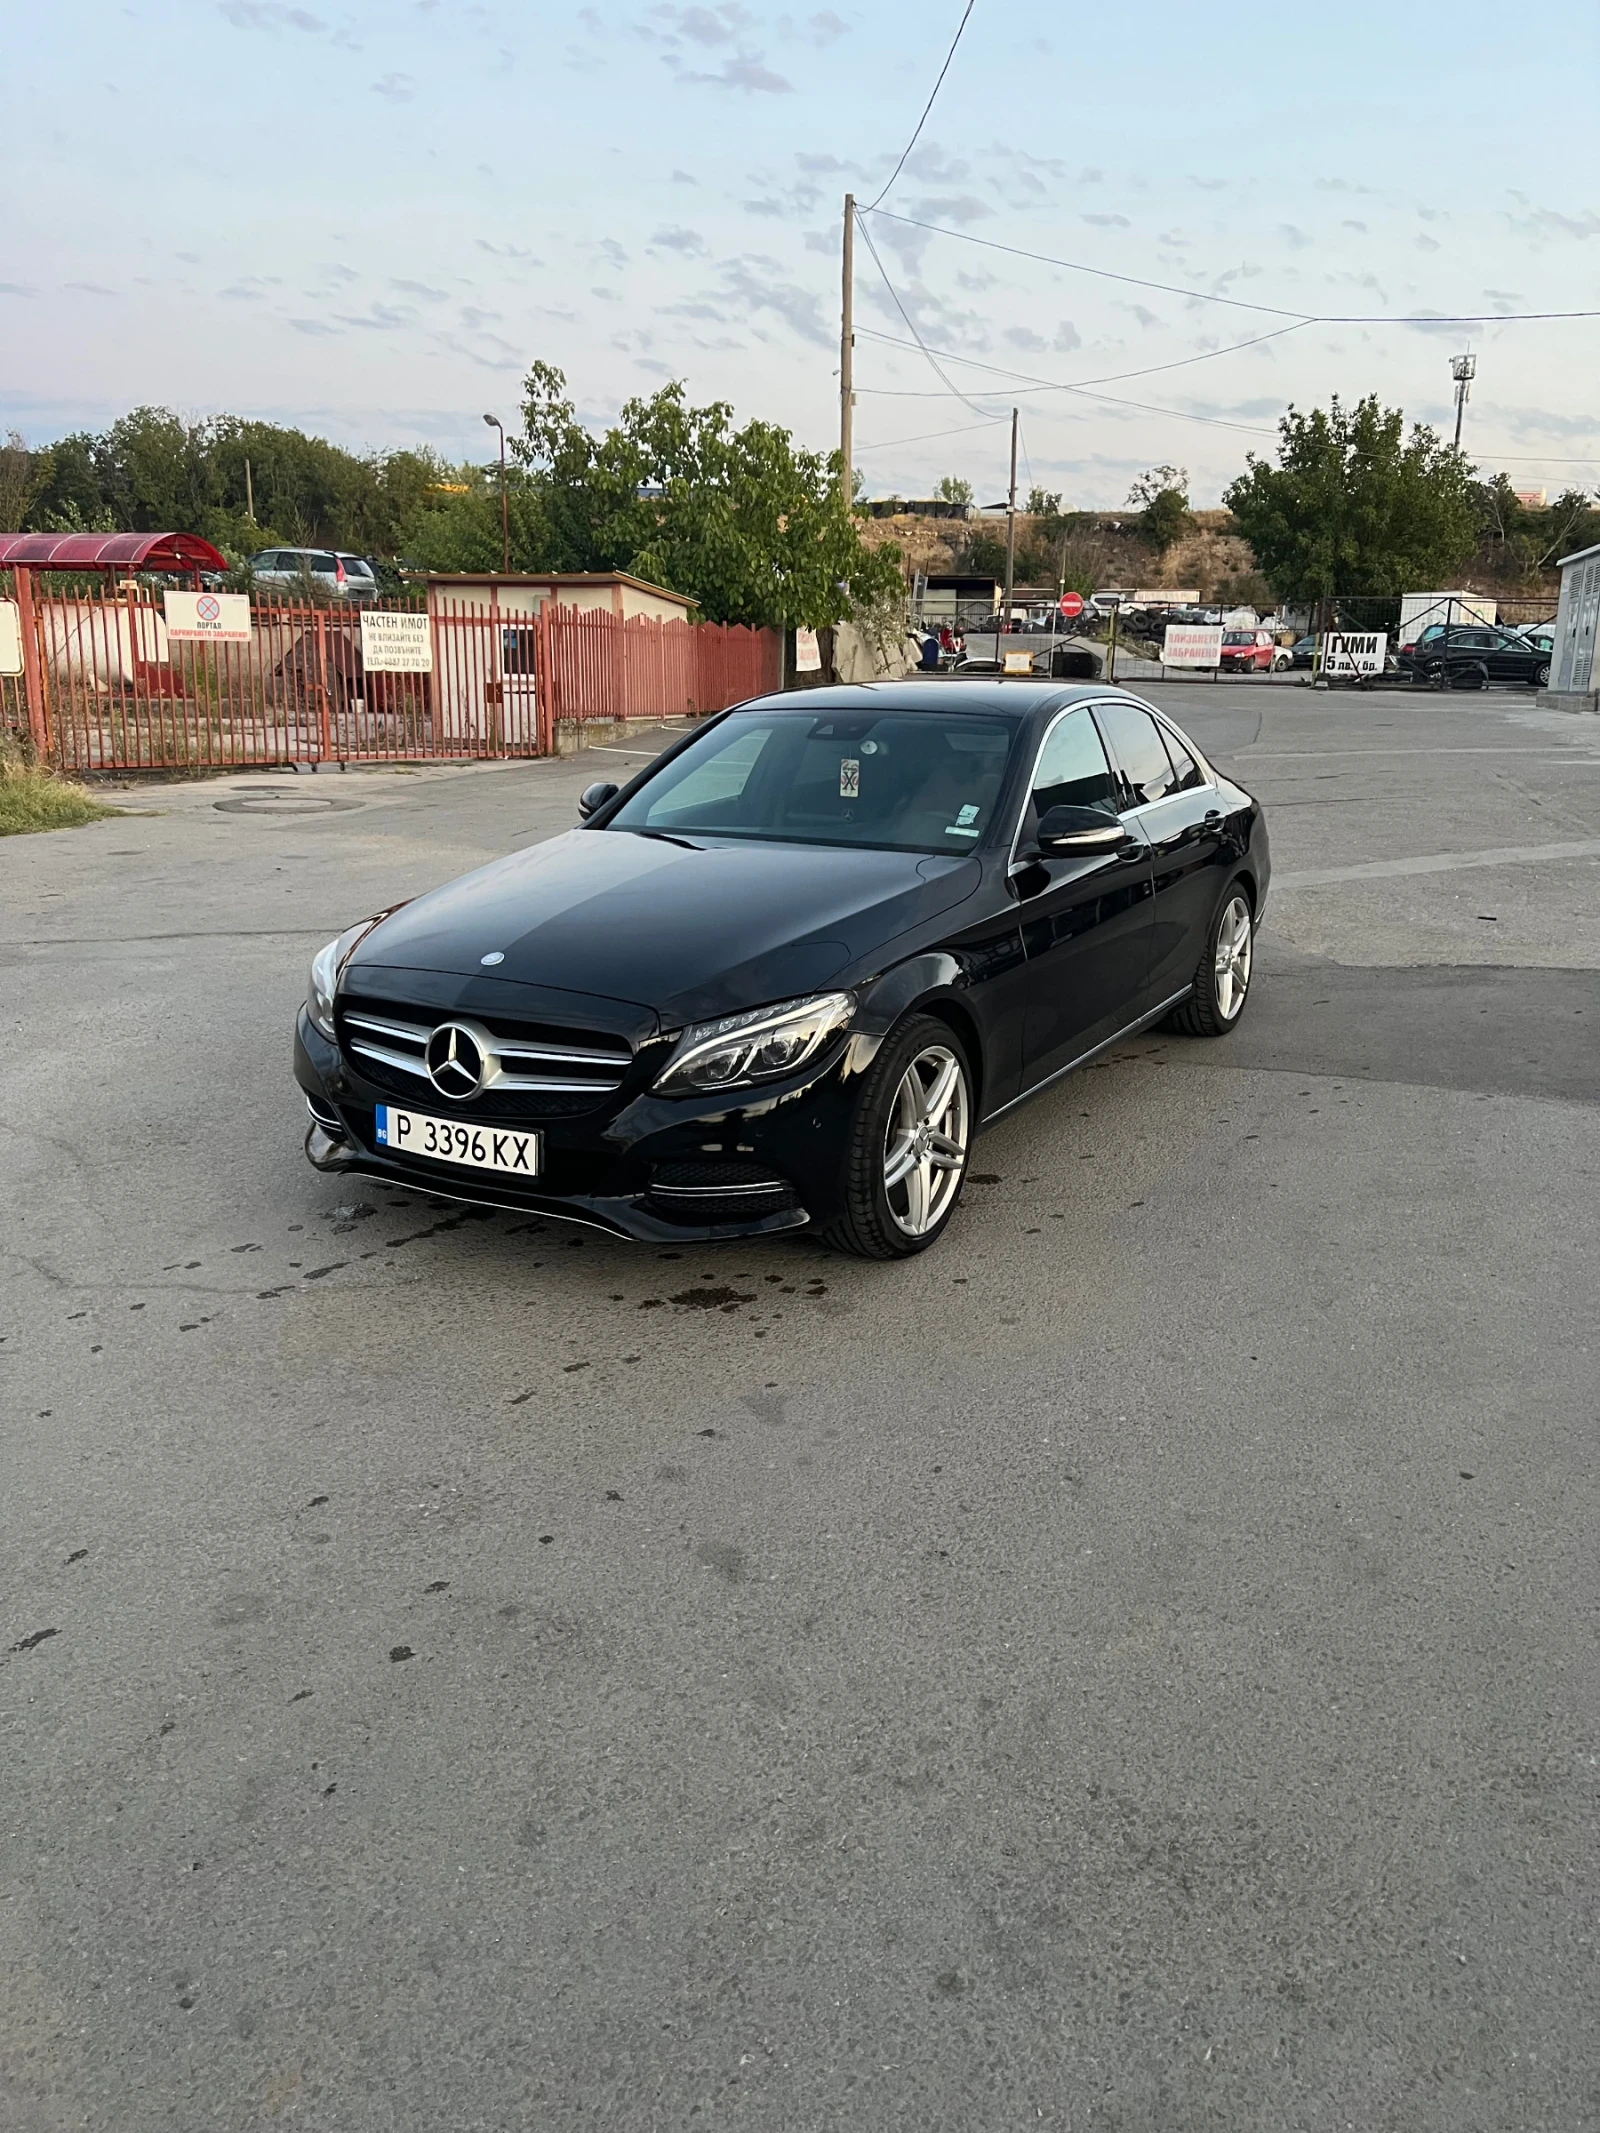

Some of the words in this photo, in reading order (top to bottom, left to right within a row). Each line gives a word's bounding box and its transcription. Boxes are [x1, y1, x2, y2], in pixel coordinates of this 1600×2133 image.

[363, 615, 398, 628] ЧАСТЕН
[401, 617, 427, 629] ИМОТ
[368, 633, 376, 641] НЕ
[378, 632, 411, 642] ВЛИЗАЙТЕ
[412, 634, 424, 643] БЕЗ
[1168, 633, 1219, 644] ВЛИЗАНЕТО
[373, 645, 383, 654] ДА
[384, 645, 421, 654] ПОЗВЪНИТЕ
[1331, 636, 1378, 653] ГУМИ
[1167, 647, 1218, 658] ЗАБРАНЕНО
[1326, 656, 1336, 670] 5
[1338, 661, 1353, 670] лв.
[1362, 661, 1377, 671] бр.
[377, 1128, 387, 1139] BG
[397, 1114, 411, 1144] P
[424, 1121, 486, 1162] 3396
[493, 1133, 530, 1170] KX
